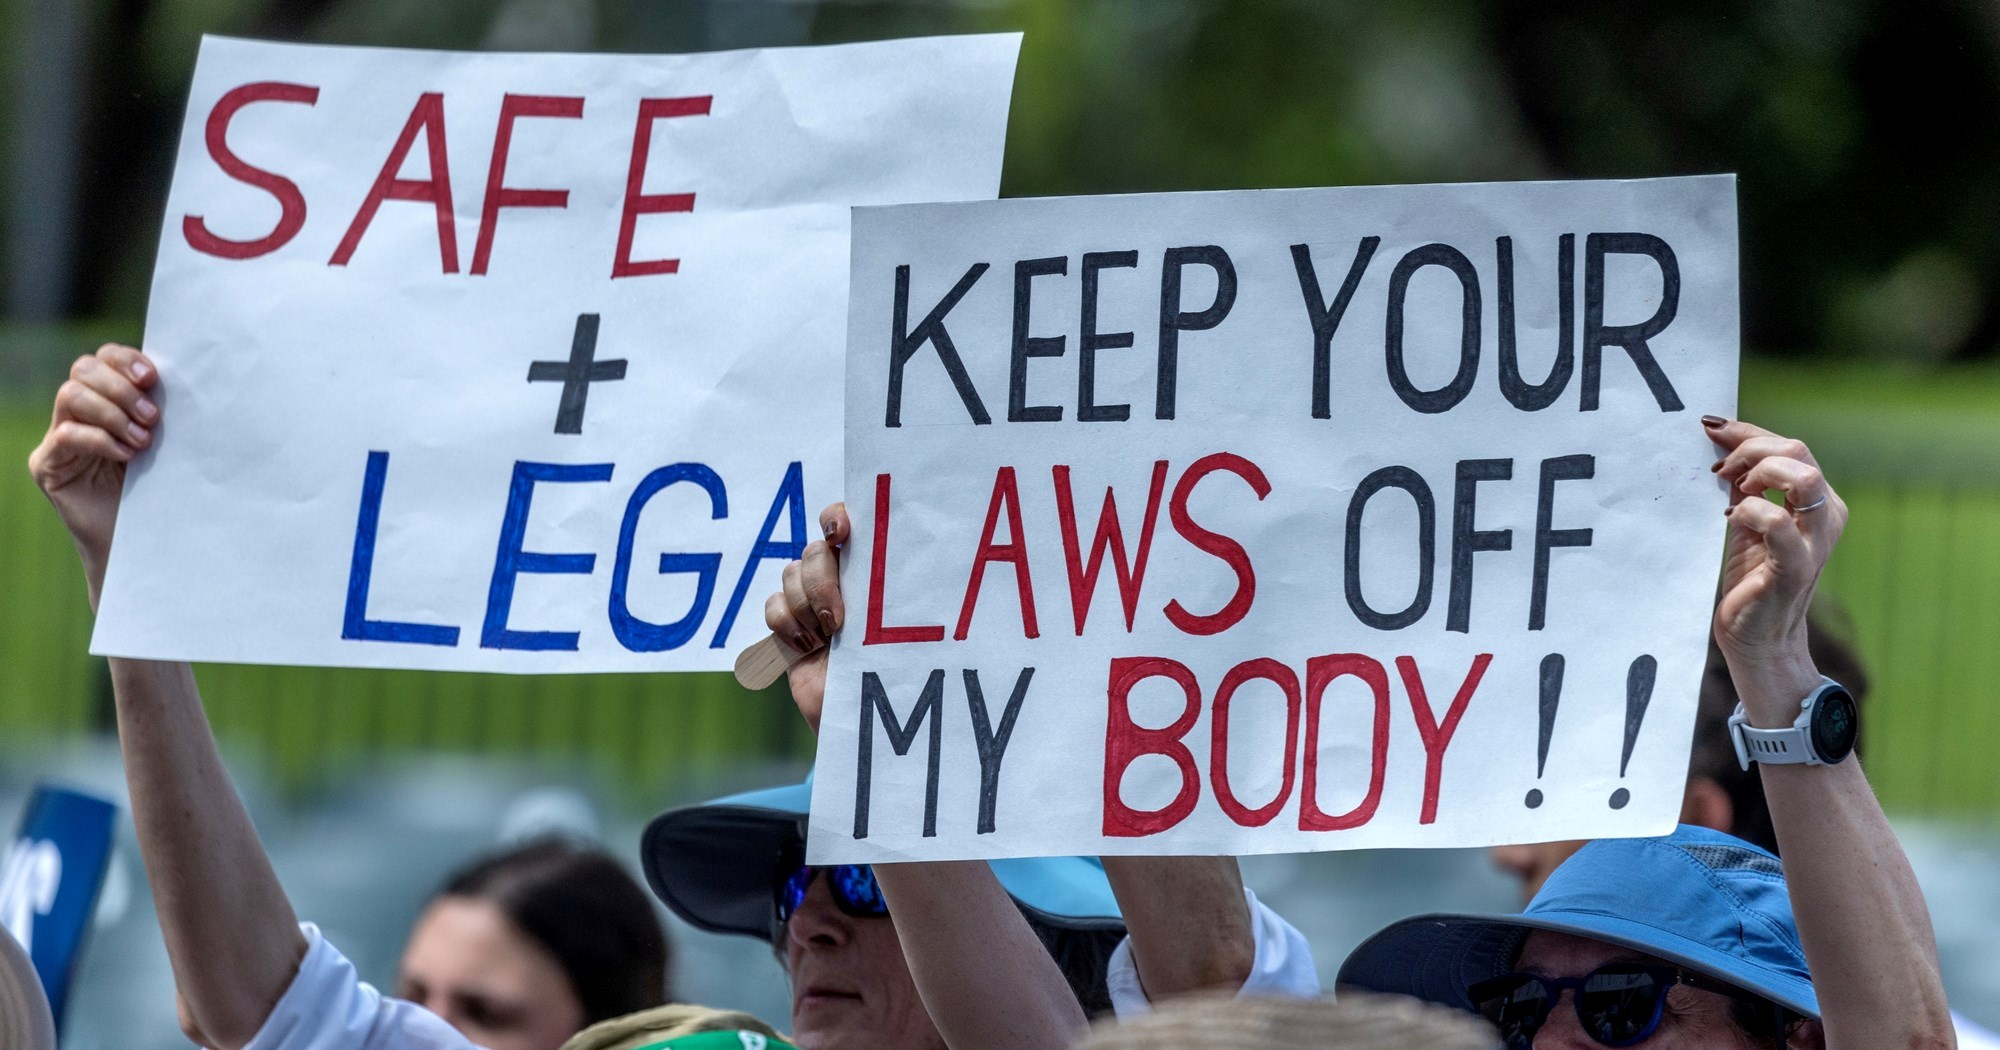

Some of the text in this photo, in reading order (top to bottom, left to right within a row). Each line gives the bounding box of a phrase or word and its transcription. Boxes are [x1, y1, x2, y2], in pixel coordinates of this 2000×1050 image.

[182, 81, 713, 279] SAFE
[527, 314, 628, 434] +
[885, 232, 1685, 428] KEEP YOUR
[863, 452, 1595, 646] LAWS OFF
[853, 667, 1035, 839] MY
[1102, 653, 1493, 837] BODY
